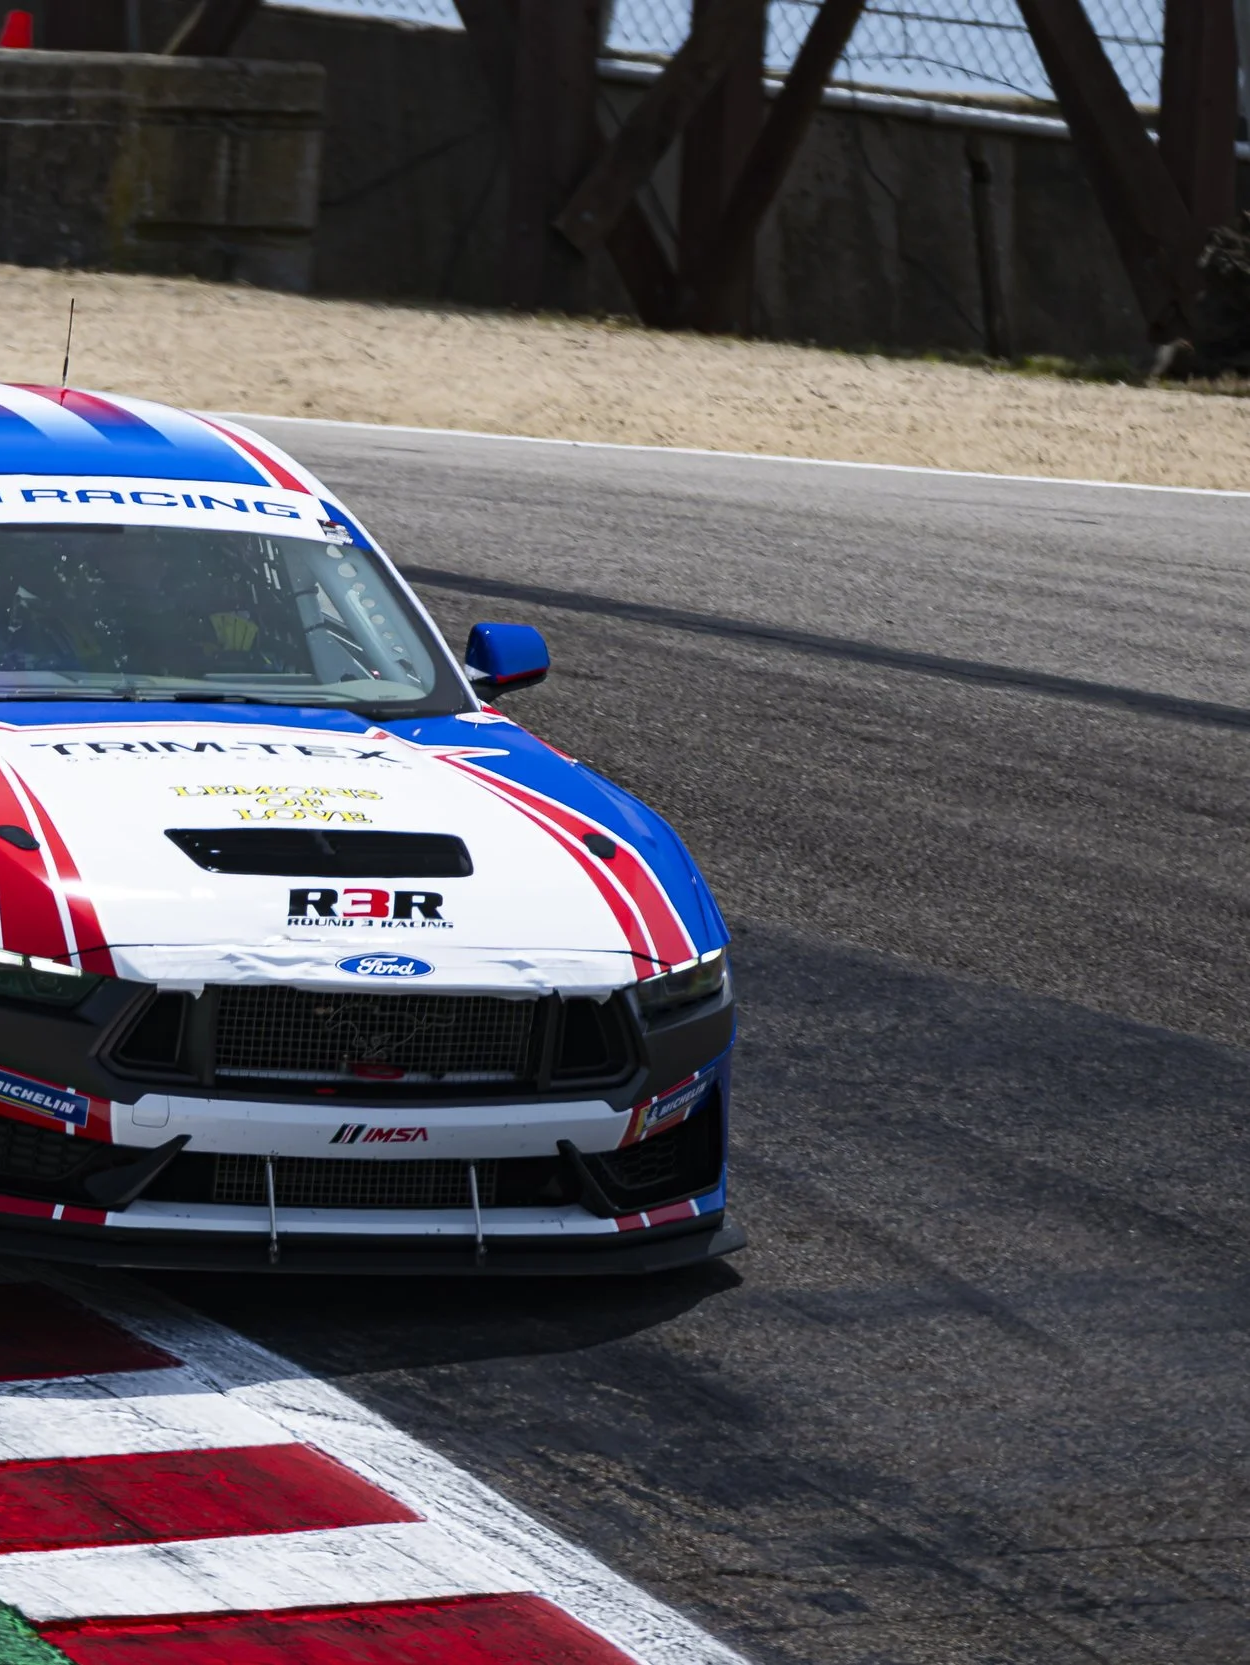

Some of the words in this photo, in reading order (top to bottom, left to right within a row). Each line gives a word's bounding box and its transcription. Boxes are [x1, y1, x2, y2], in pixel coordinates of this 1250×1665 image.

[21, 489, 301, 519] RACING
[30, 741, 402, 763] TRIM-TEX
[169, 785, 384, 800] LEMONS
[256, 796, 323, 808] OF
[232, 808, 373, 823] LOVE
[287, 888, 444, 920] R3R
[287, 918, 354, 927] ROUND
[360, 919, 374, 927] 3
[381, 919, 454, 929] RACING
[356, 957, 416, 975] Ford
[361, 1127, 429, 1143] IMSA
